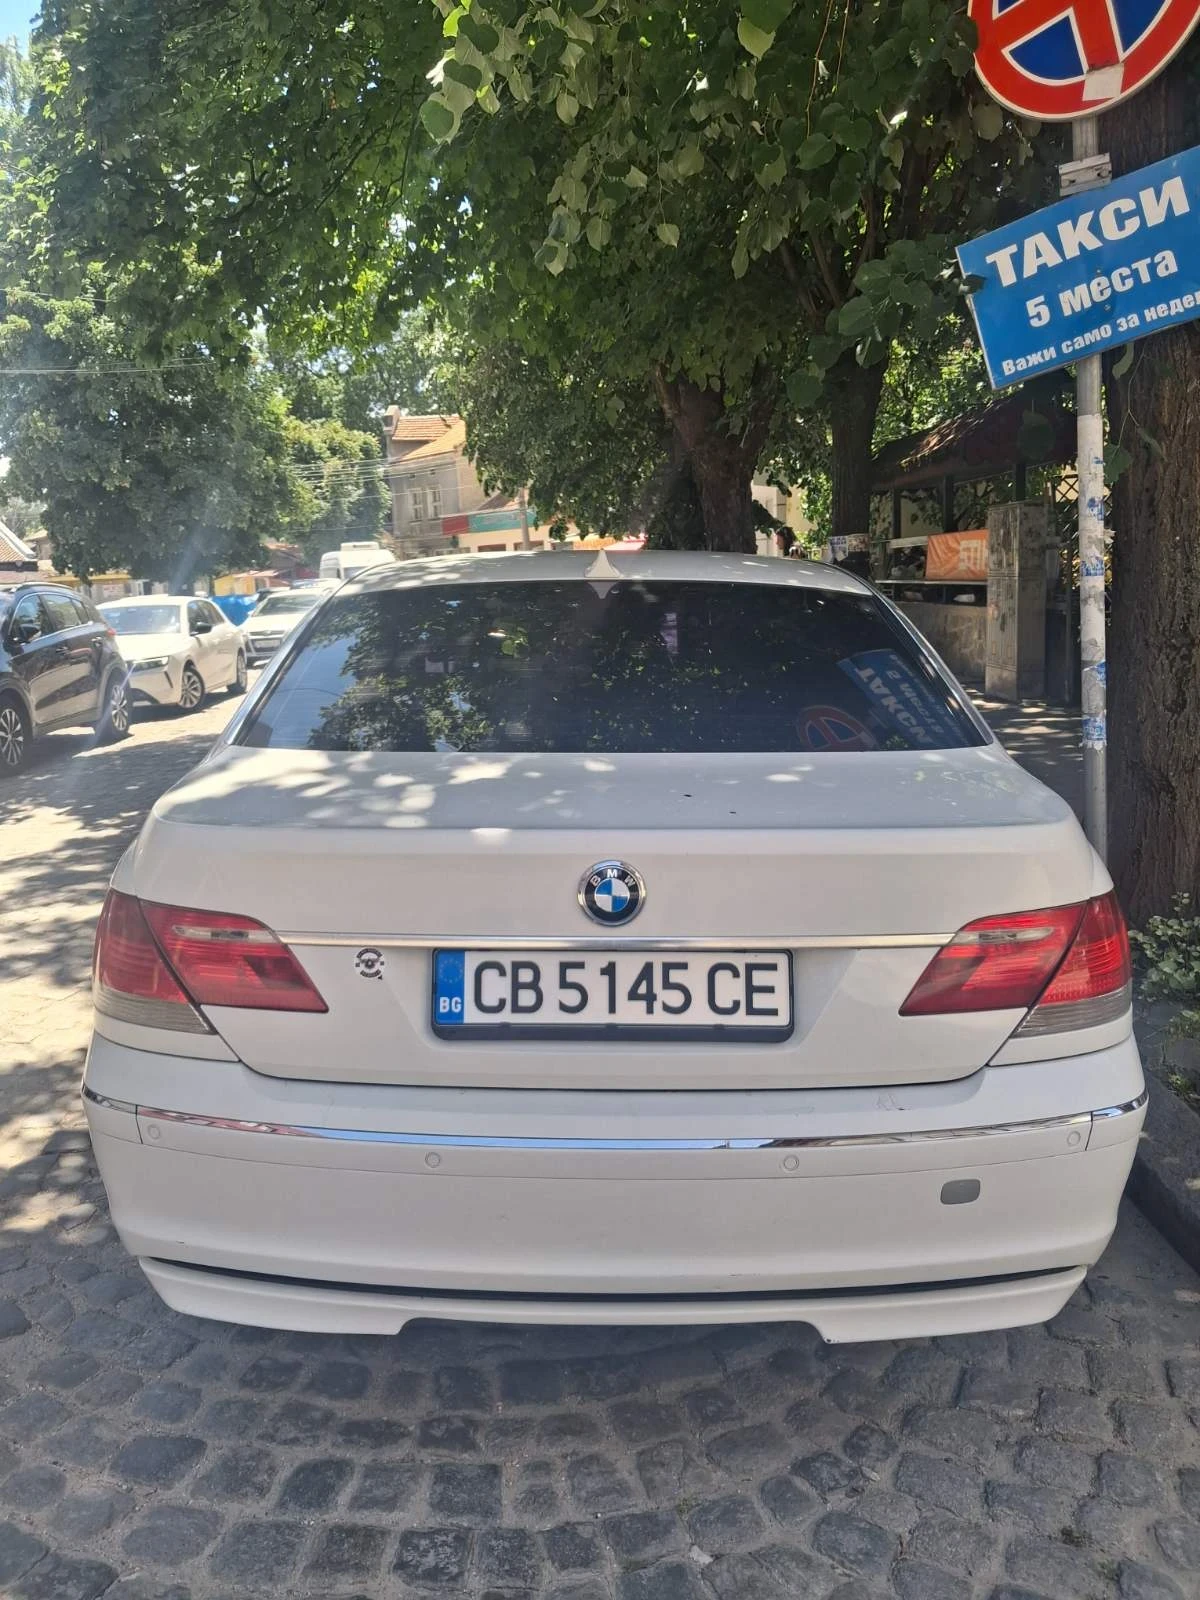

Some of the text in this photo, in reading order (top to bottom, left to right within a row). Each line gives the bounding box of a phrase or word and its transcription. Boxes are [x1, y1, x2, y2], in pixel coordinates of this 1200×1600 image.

[985, 176, 1190, 287] ТАКСИ
[1025, 250, 1178, 328] 5 места
[1002, 347, 1057, 376] Важи
[1061, 324, 1112, 354] само
[1116, 313, 1140, 332] за
[590, 868, 636, 888] BMW
[439, 996, 462, 1013] BG
[474, 960, 779, 1017] CB 5145 CE
